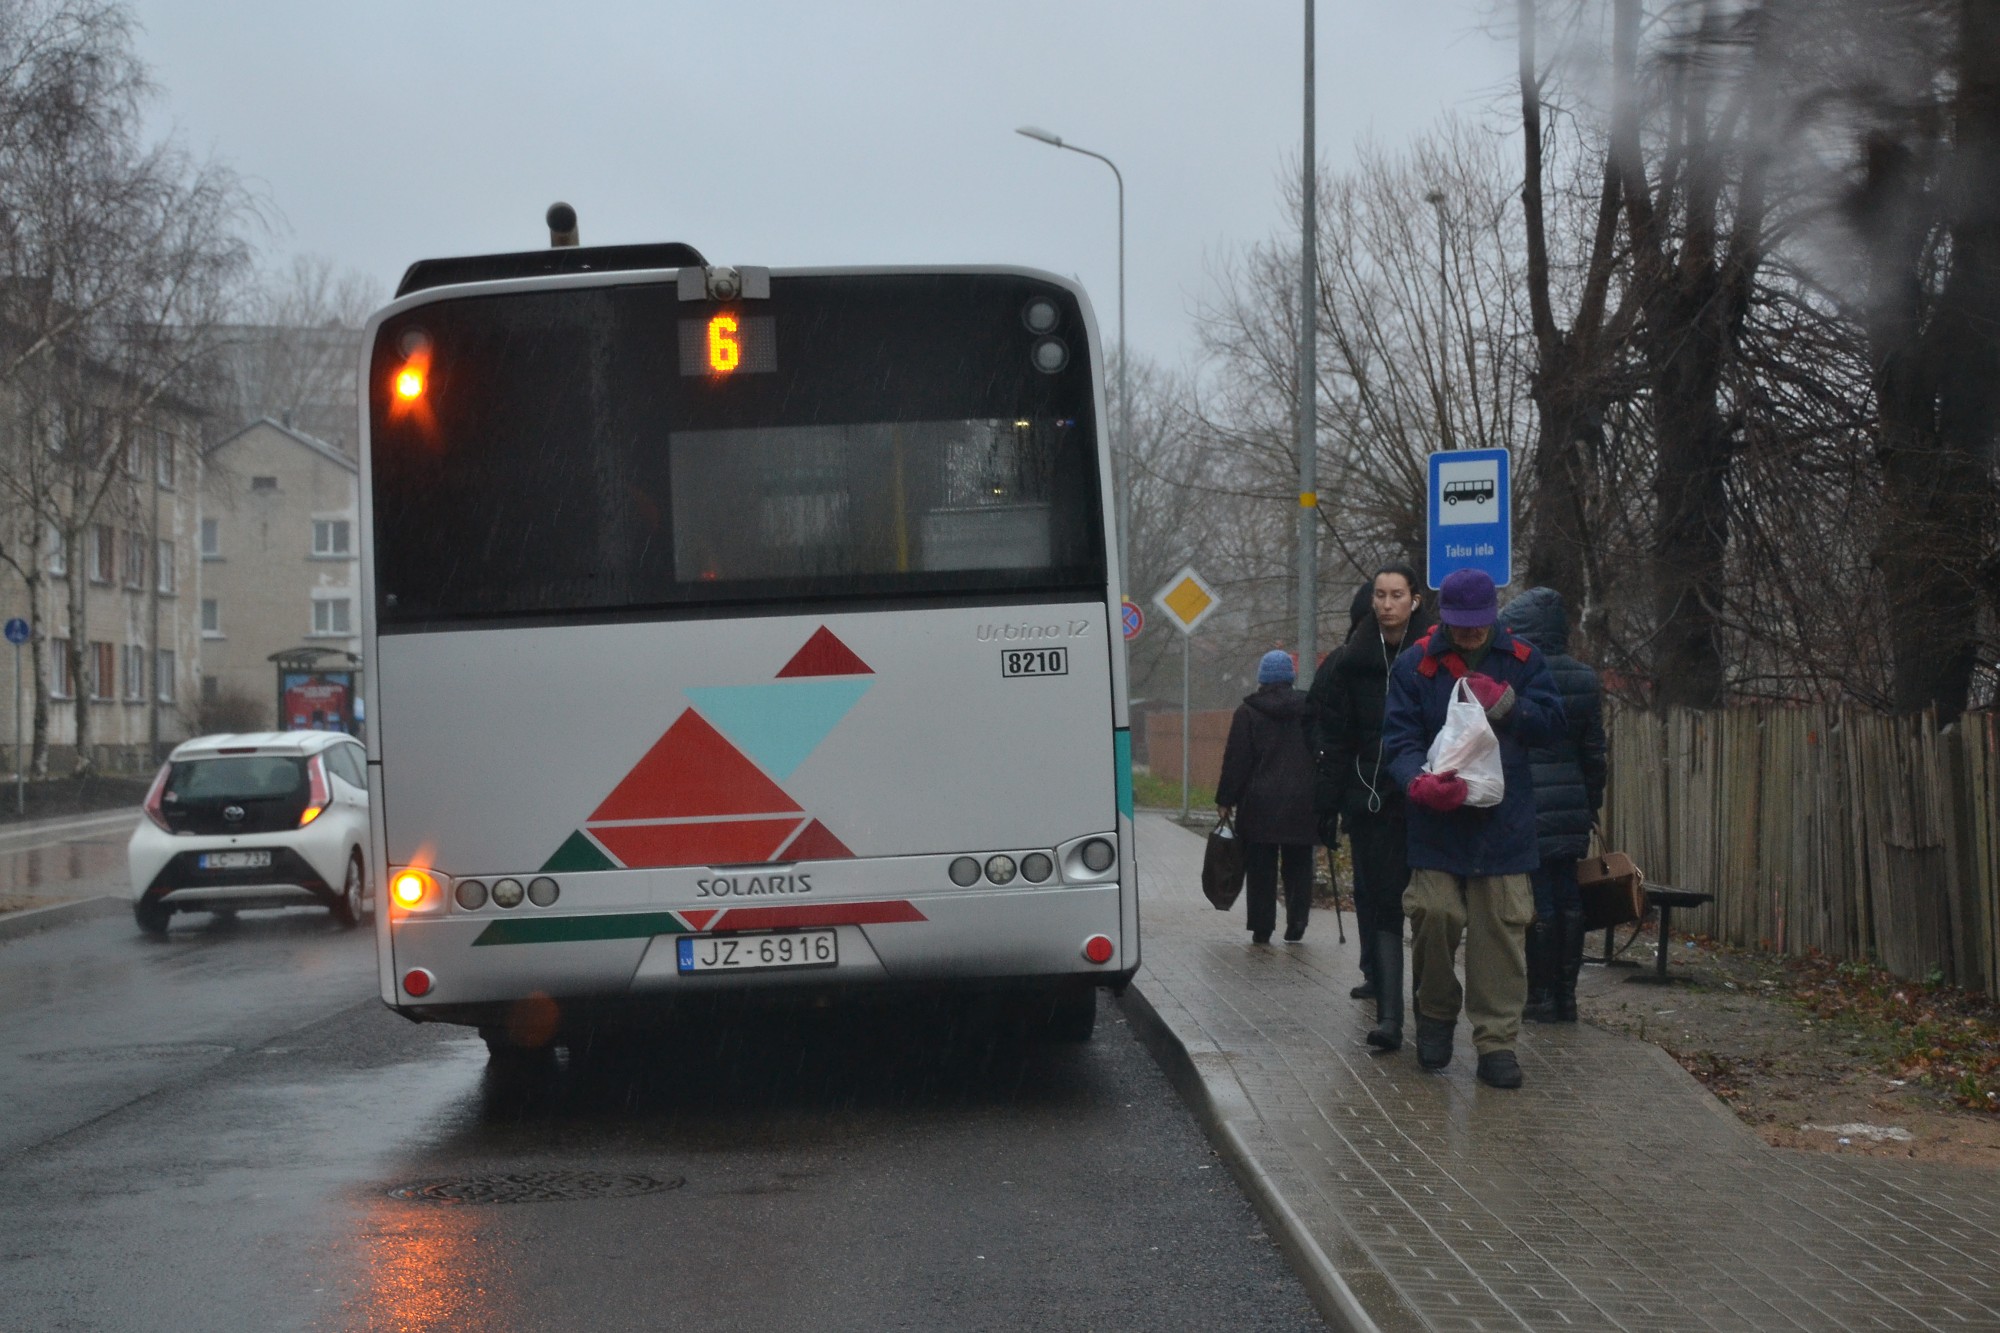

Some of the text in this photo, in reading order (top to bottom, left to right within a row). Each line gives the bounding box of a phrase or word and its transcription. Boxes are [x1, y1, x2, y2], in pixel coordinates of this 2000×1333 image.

[709, 316, 738, 371] 6
[1445, 542, 1495, 558] Talsu iela
[976, 619, 1091, 642] Urbino 12
[1008, 651, 1061, 674] 8210
[696, 874, 812, 898] SOLARIS
[680, 956, 693, 966] LV
[701, 936, 830, 966] JZ-6916
